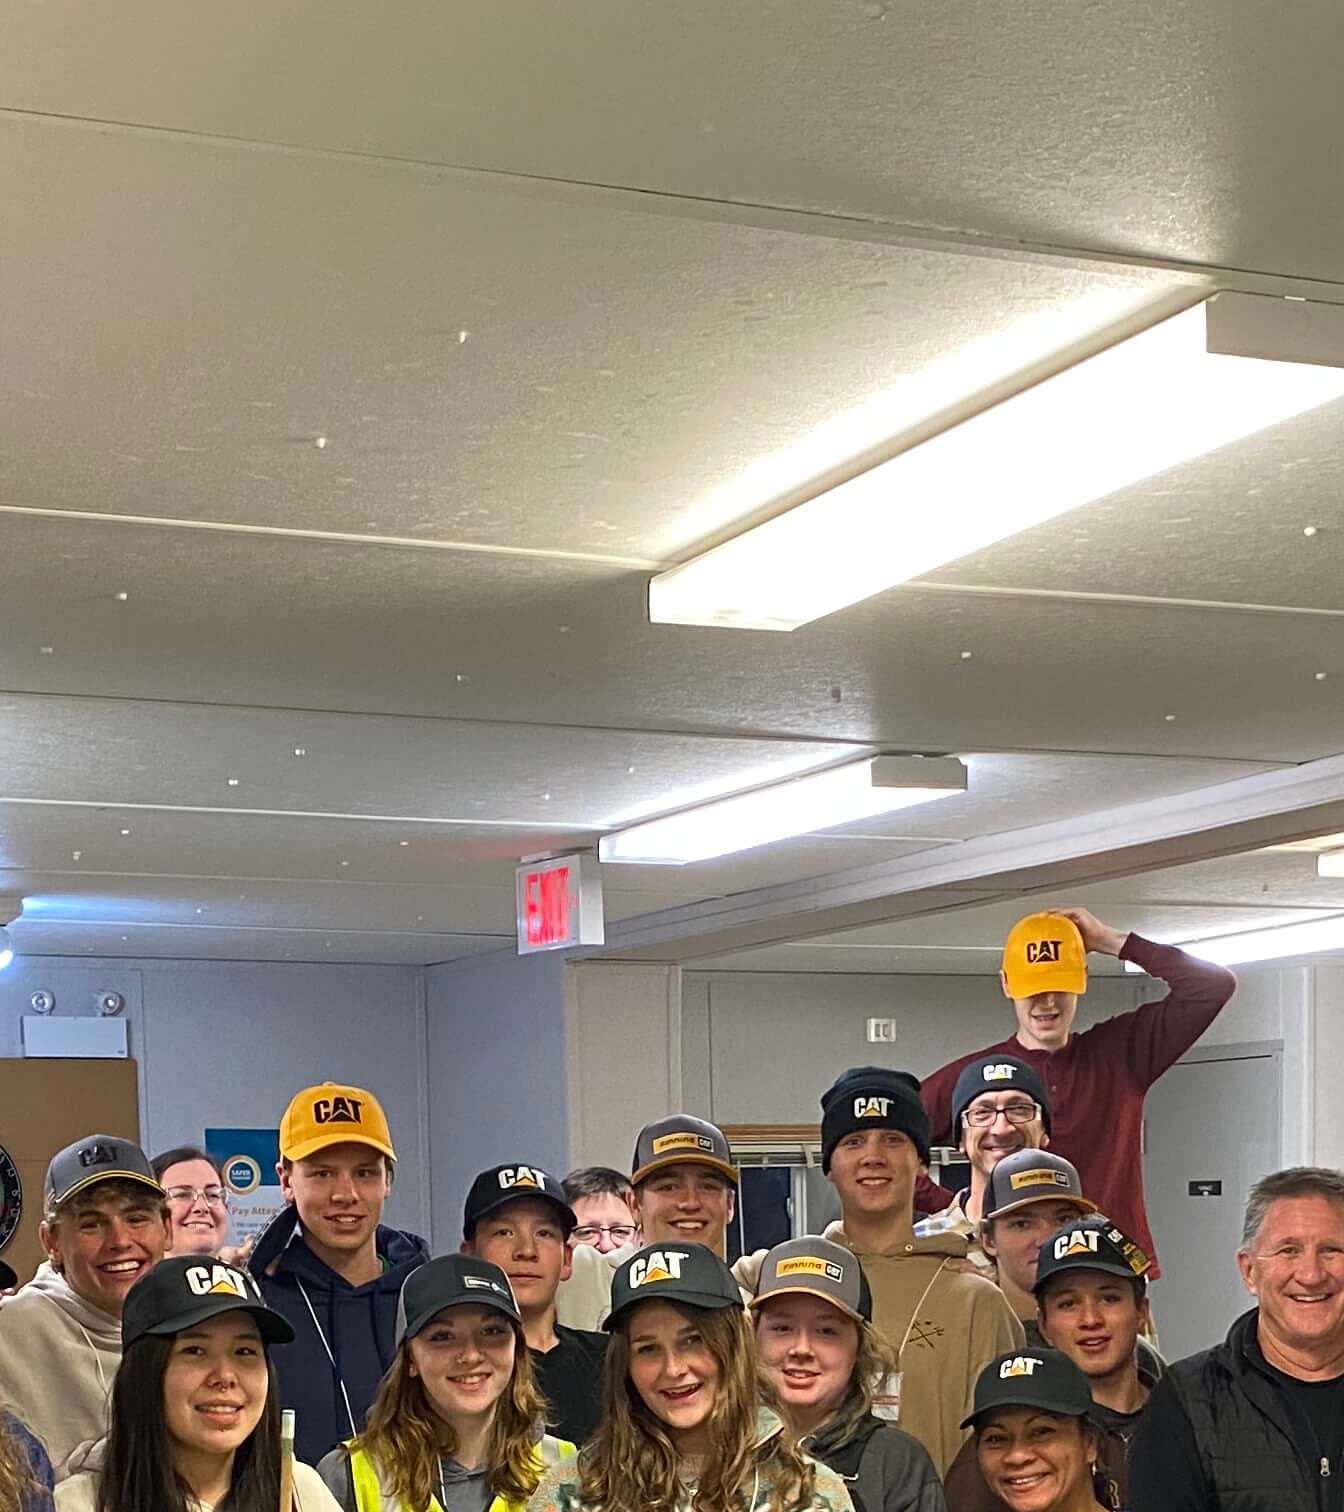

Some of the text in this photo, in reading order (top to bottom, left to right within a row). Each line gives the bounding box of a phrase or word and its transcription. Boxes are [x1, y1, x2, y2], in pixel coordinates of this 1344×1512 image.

[1027, 940, 1063, 963] CAT
[983, 1064, 1017, 1081] CAT
[313, 1097, 364, 1124] CAT
[853, 1097, 894, 1118] CAT
[499, 1166, 548, 1190] CAT
[1053, 1229, 1102, 1260] CAT
[185, 1264, 248, 1299] CAT
[629, 1251, 690, 1289] CAT
[1000, 1356, 1043, 1379] CAT
